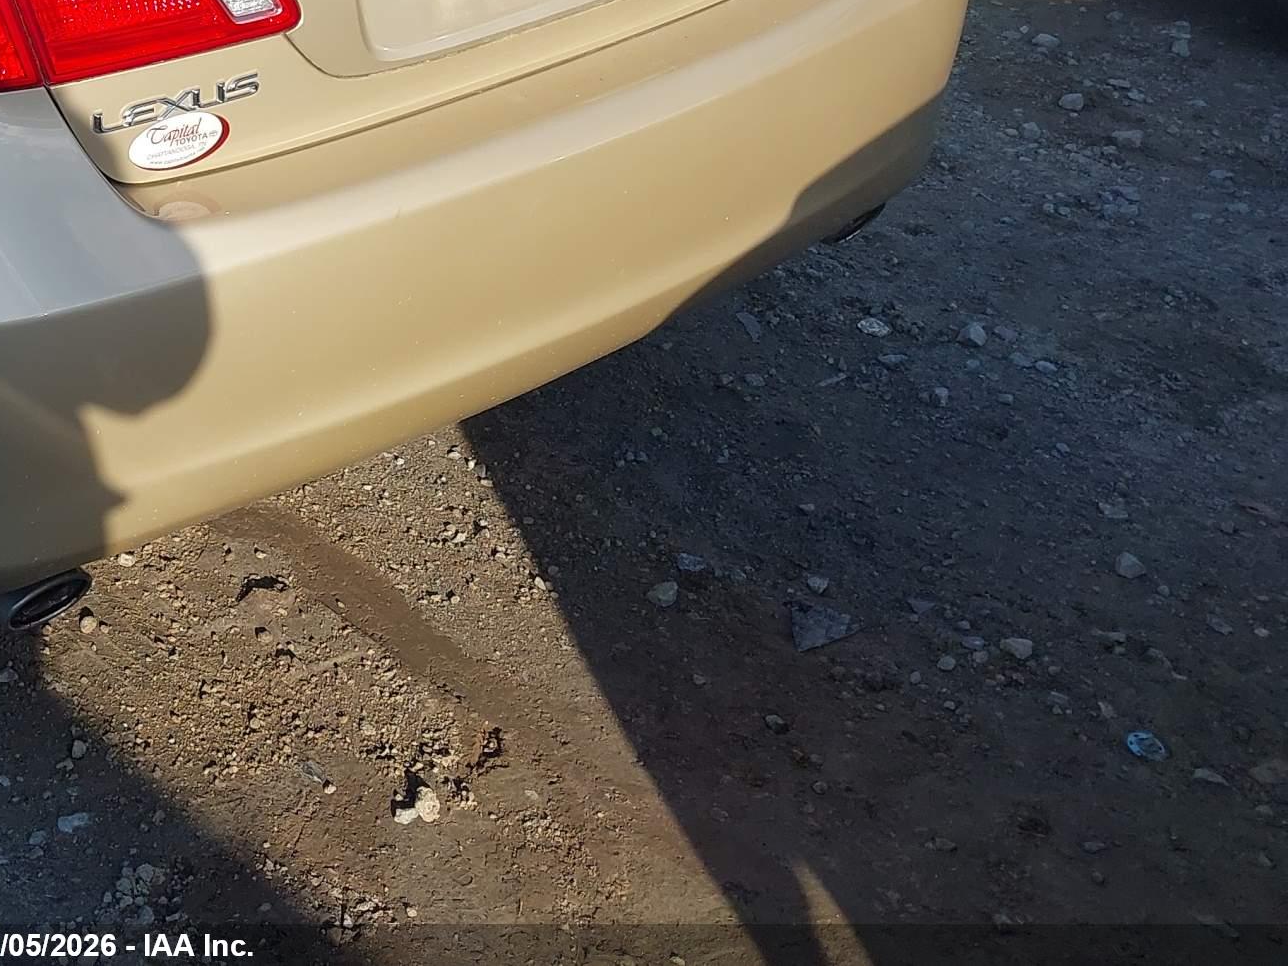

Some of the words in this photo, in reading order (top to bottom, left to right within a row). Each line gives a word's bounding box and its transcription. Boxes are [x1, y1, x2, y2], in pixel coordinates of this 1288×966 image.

[91, 71, 260, 133] LEXUS
[146, 117, 202, 146] Capital
[175, 132, 209, 146] TOYOTA
